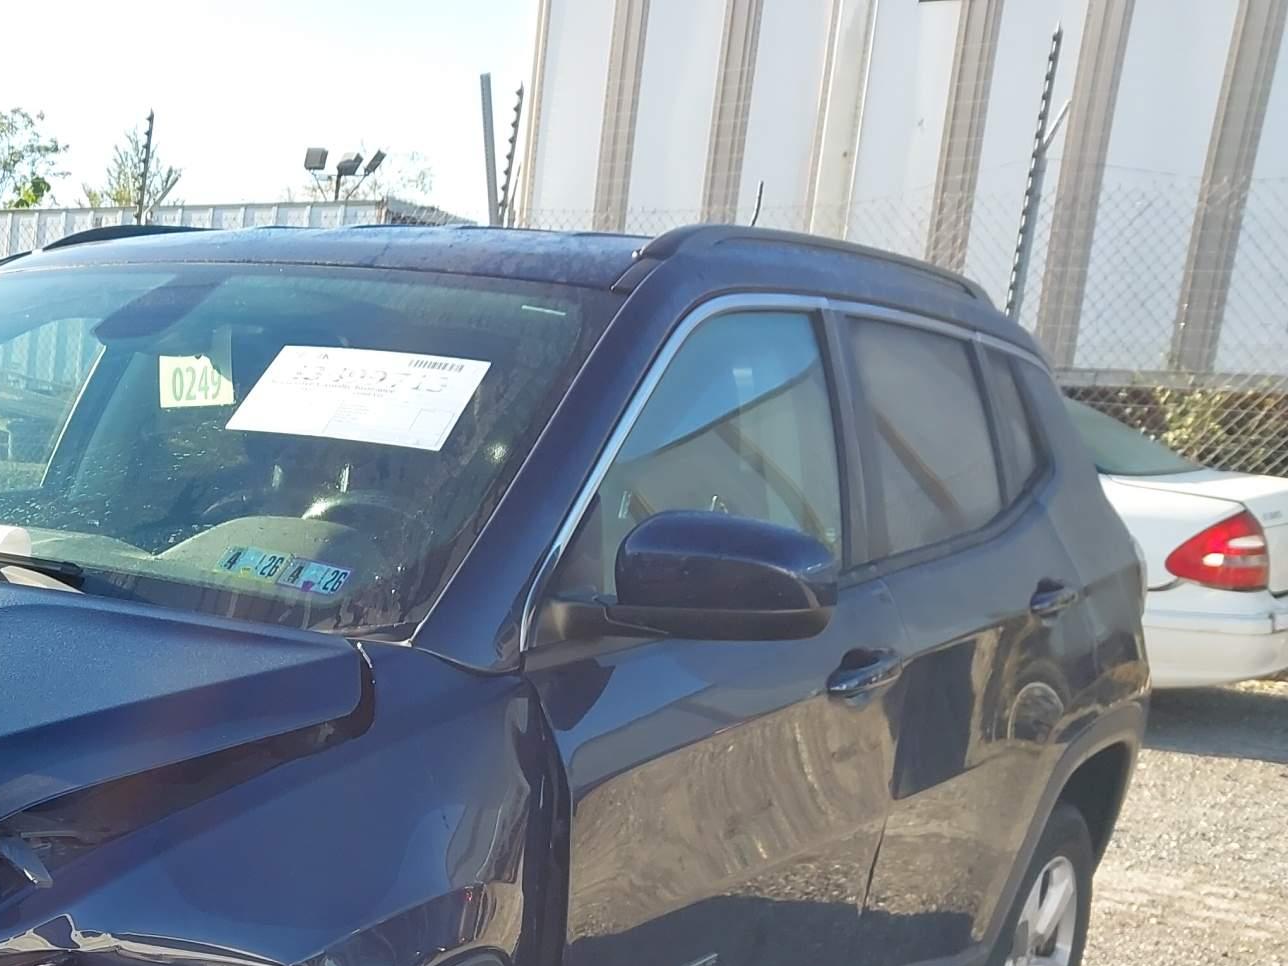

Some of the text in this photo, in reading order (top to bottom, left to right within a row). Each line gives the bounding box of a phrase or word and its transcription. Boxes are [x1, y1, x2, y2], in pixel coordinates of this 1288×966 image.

[171, 365, 222, 402] 0249
[223, 551, 285, 577] 4 26
[287, 565, 349, 593] 4 26
